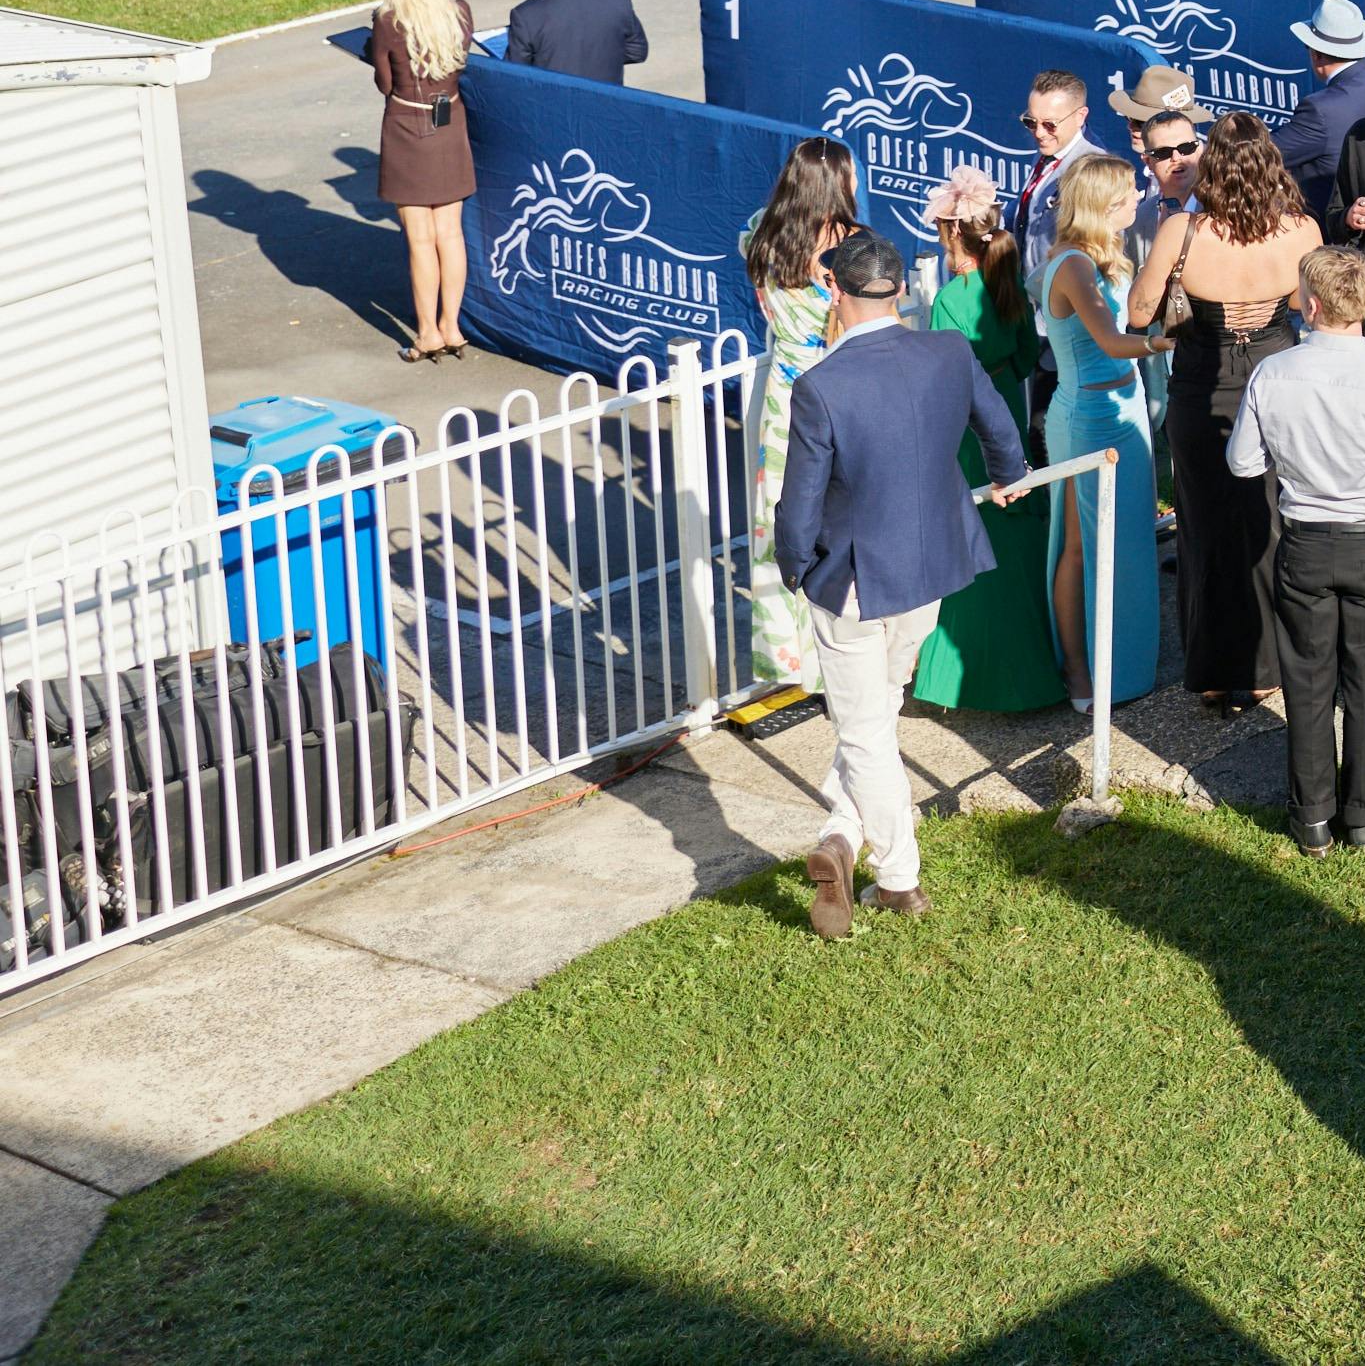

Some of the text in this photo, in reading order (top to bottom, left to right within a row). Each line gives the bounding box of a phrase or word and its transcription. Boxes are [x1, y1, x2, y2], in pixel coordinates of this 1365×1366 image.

[1210, 67, 1299, 111] HARBOUR
[867, 132, 928, 174] COFFS
[550, 234, 719, 305] COFFS HARBOUR
[561, 279, 709, 326] RACING CLUB
